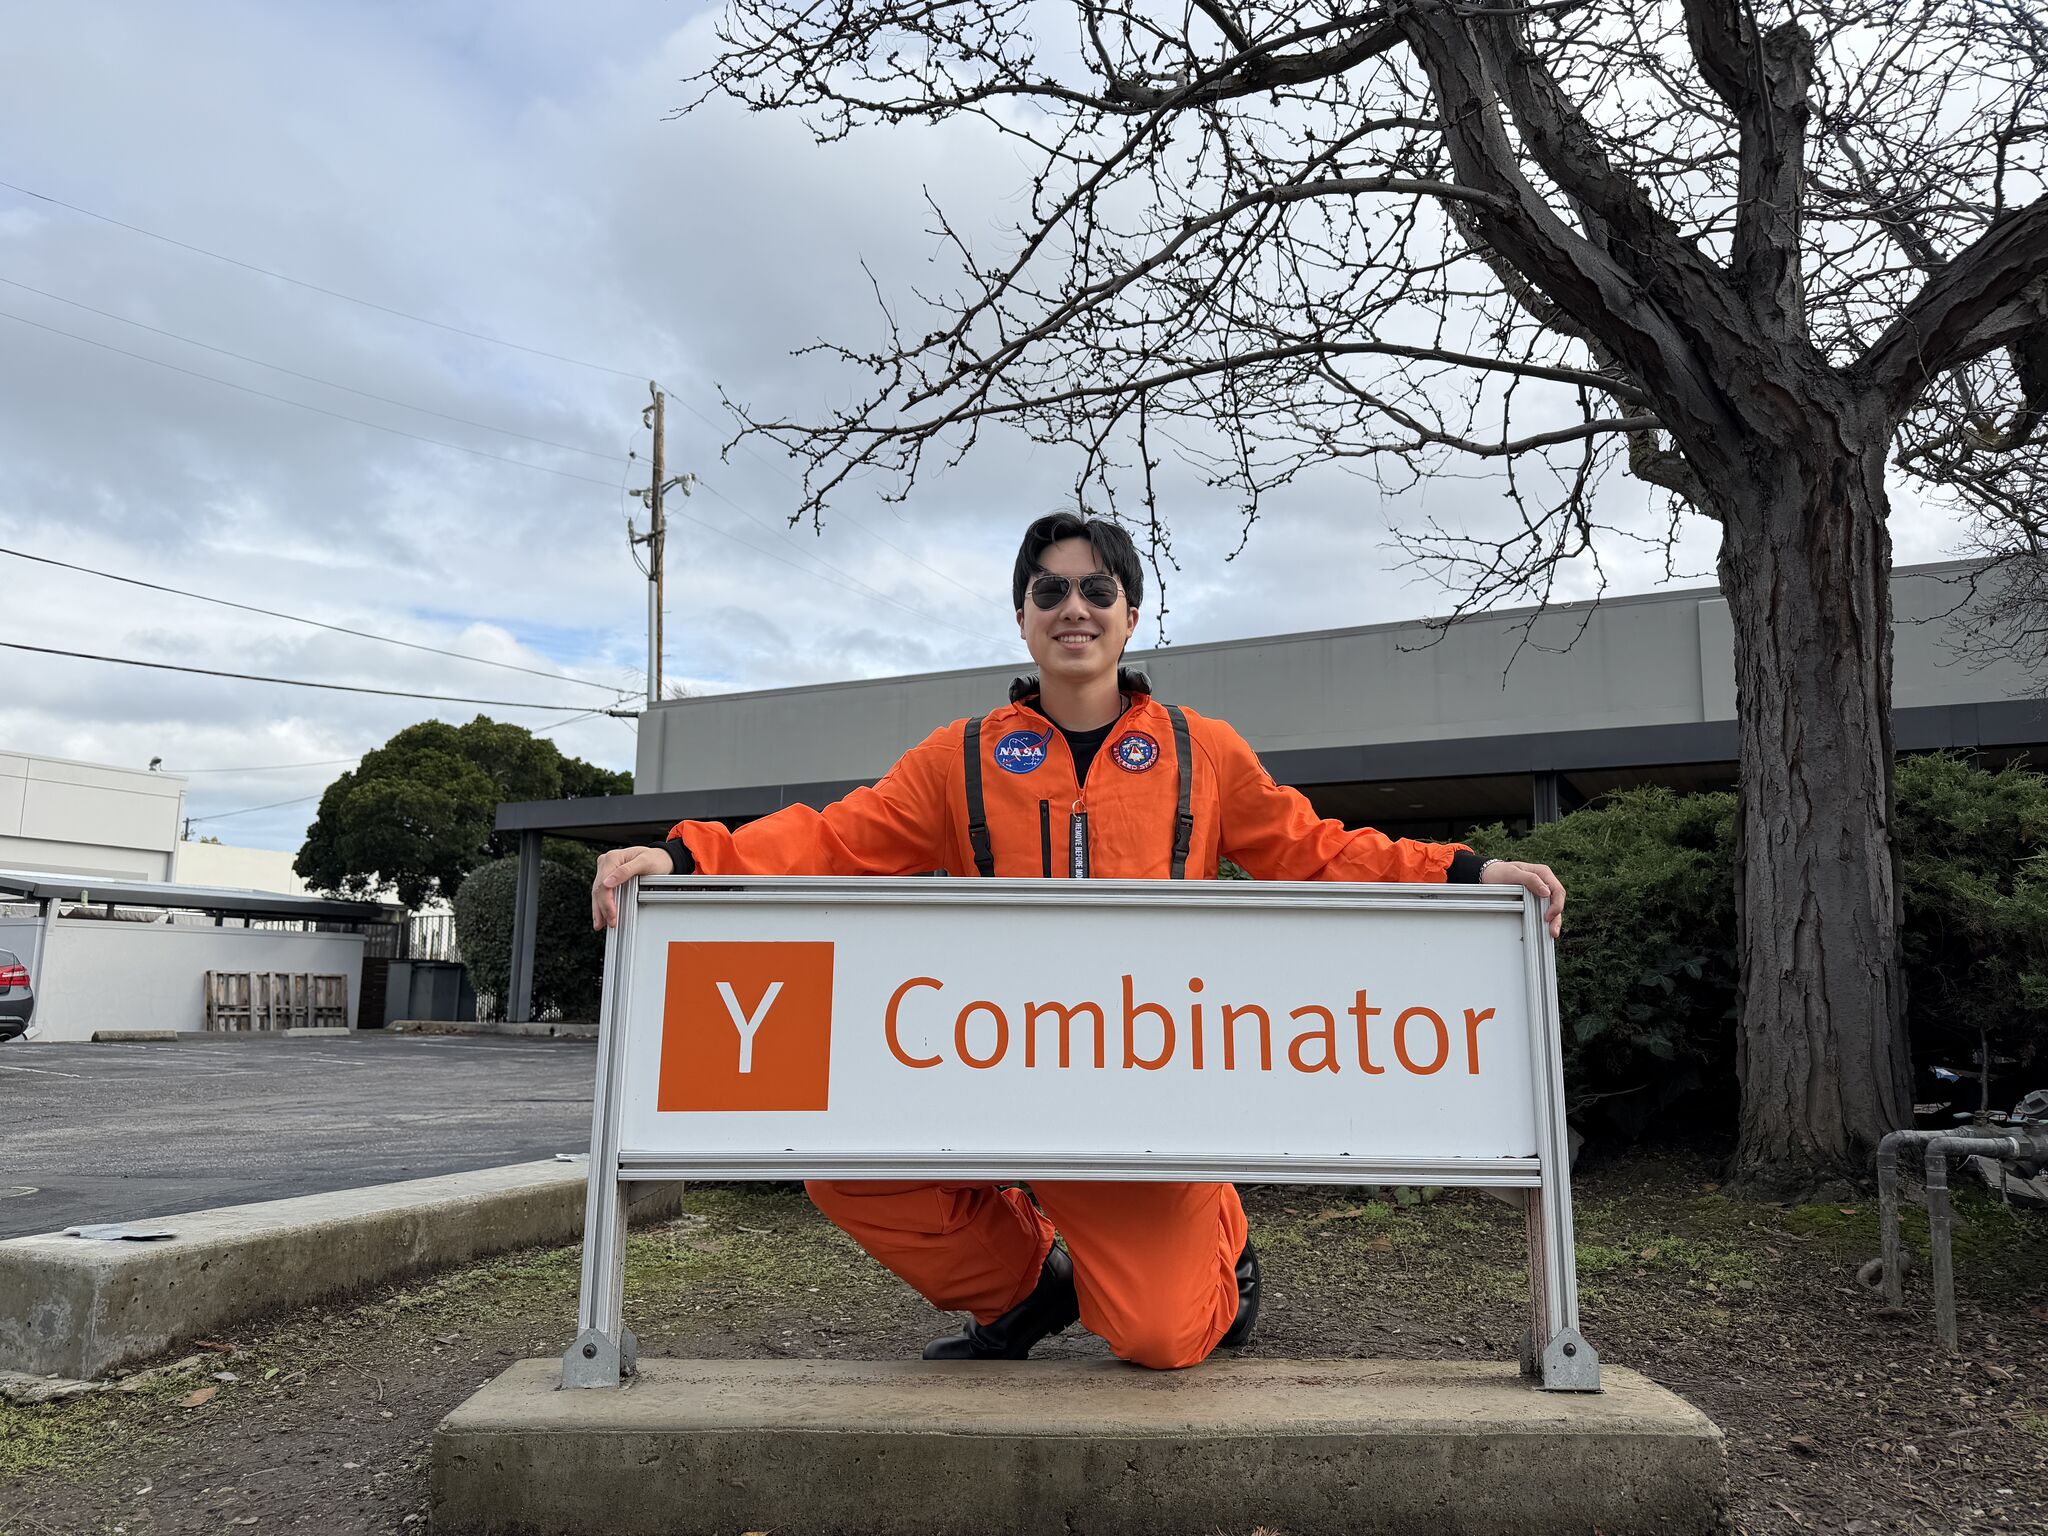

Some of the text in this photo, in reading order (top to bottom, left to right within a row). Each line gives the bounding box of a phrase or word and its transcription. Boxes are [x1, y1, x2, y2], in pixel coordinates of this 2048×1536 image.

[999, 747, 1043, 757] NASA
[1138, 748, 1158, 770] SPACE
[1074, 822, 1083, 846] REMOVE
[1074, 846, 1084, 868] BEFORE
[715, 975, 1495, 1076] Y Combinator
